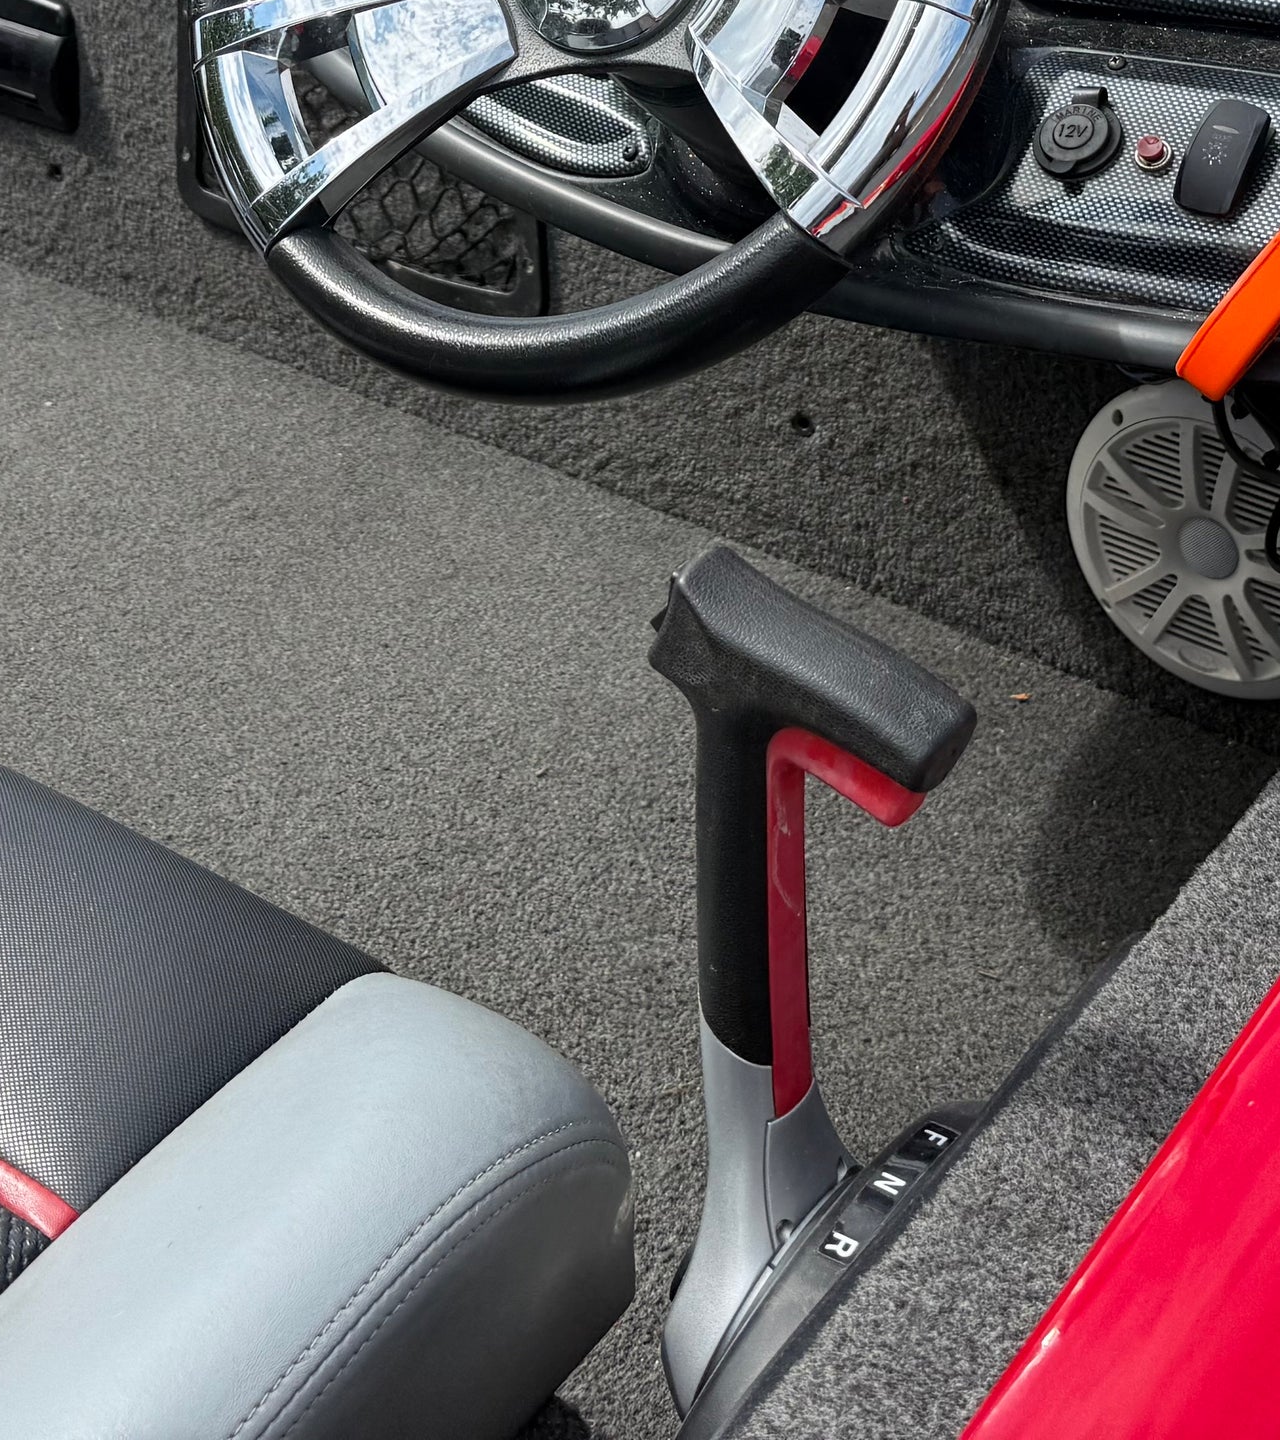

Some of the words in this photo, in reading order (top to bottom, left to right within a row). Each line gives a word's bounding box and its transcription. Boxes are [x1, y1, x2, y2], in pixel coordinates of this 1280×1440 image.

[1054, 105, 1102, 122] MARINE
[1058, 123, 1088, 138] 12V
[923, 1128, 949, 1147] F
[873, 1171, 906, 1196] N
[824, 1230, 859, 1258] R
